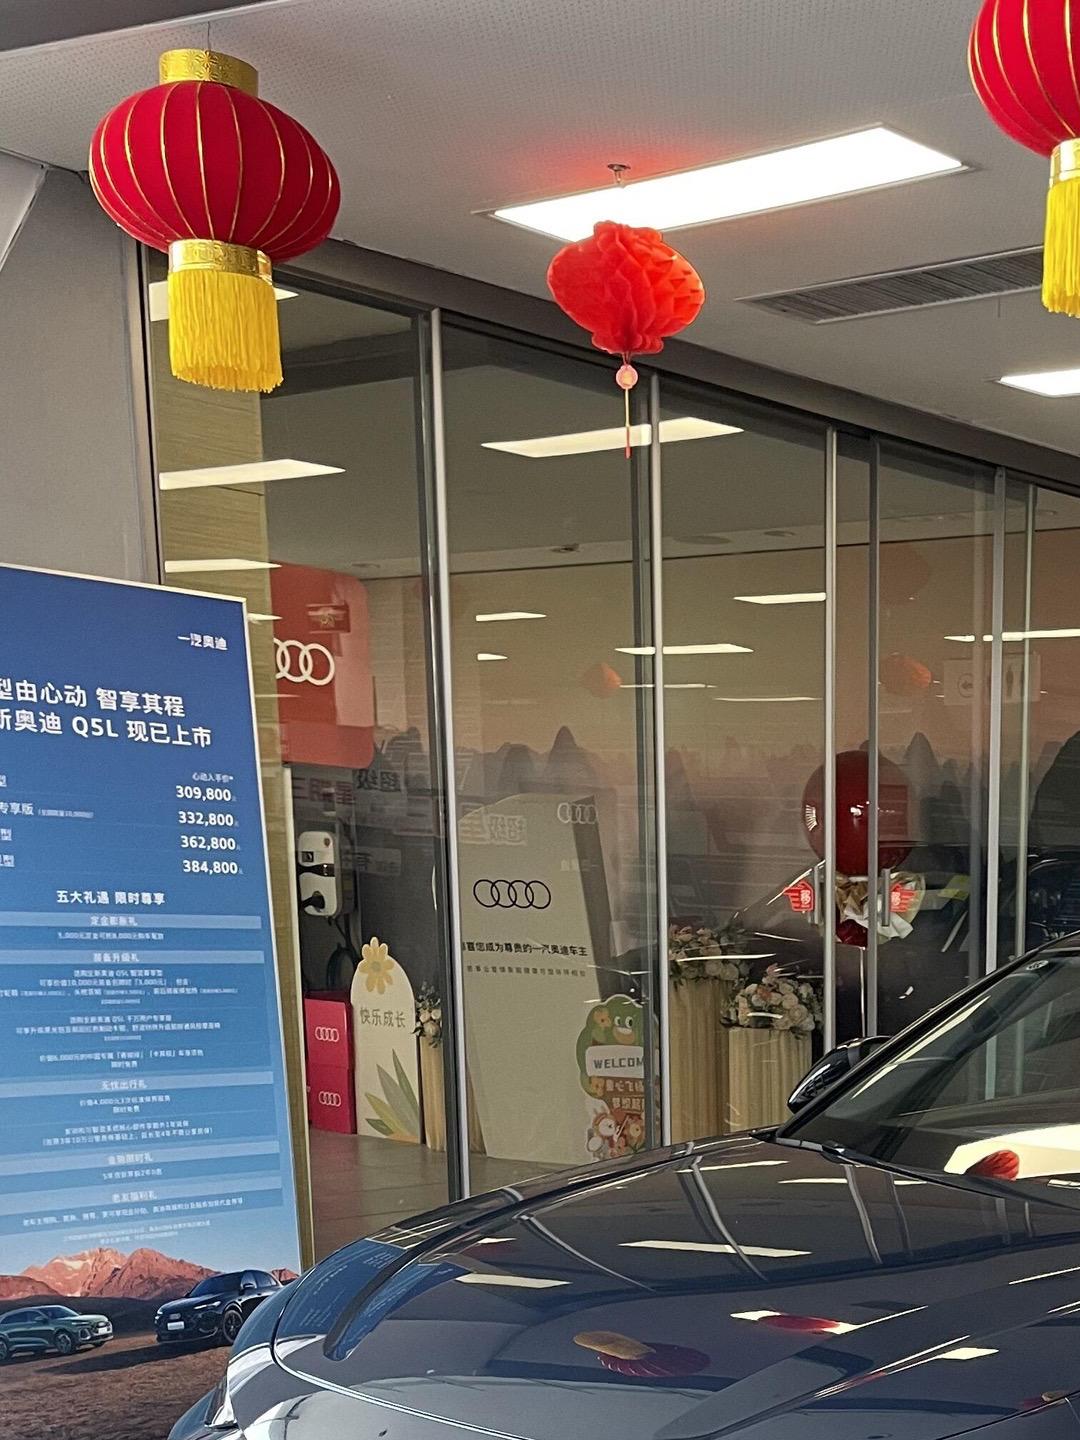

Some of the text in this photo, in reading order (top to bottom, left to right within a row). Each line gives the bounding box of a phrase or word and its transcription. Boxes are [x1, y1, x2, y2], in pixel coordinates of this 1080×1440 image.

[177, 633, 228, 650] 一汽奥迪
[95, 687, 186, 718] 智享其程
[71, 715, 119, 739] Q5L
[126, 720, 212, 749] 现已上市
[175, 785, 232, 802] 309,800
[178, 810, 234, 827] 332,800
[180, 835, 236, 851] 362,800
[182, 859, 238, 875] 384,800
[114, 891, 166, 906] 限时尊享
[462, 941, 588, 957] 喜您成为尊贵的一汽奥迪车主
[359, 1007, 406, 1028] 快乐成长
[593, 1056, 644, 1070] WELCOM
